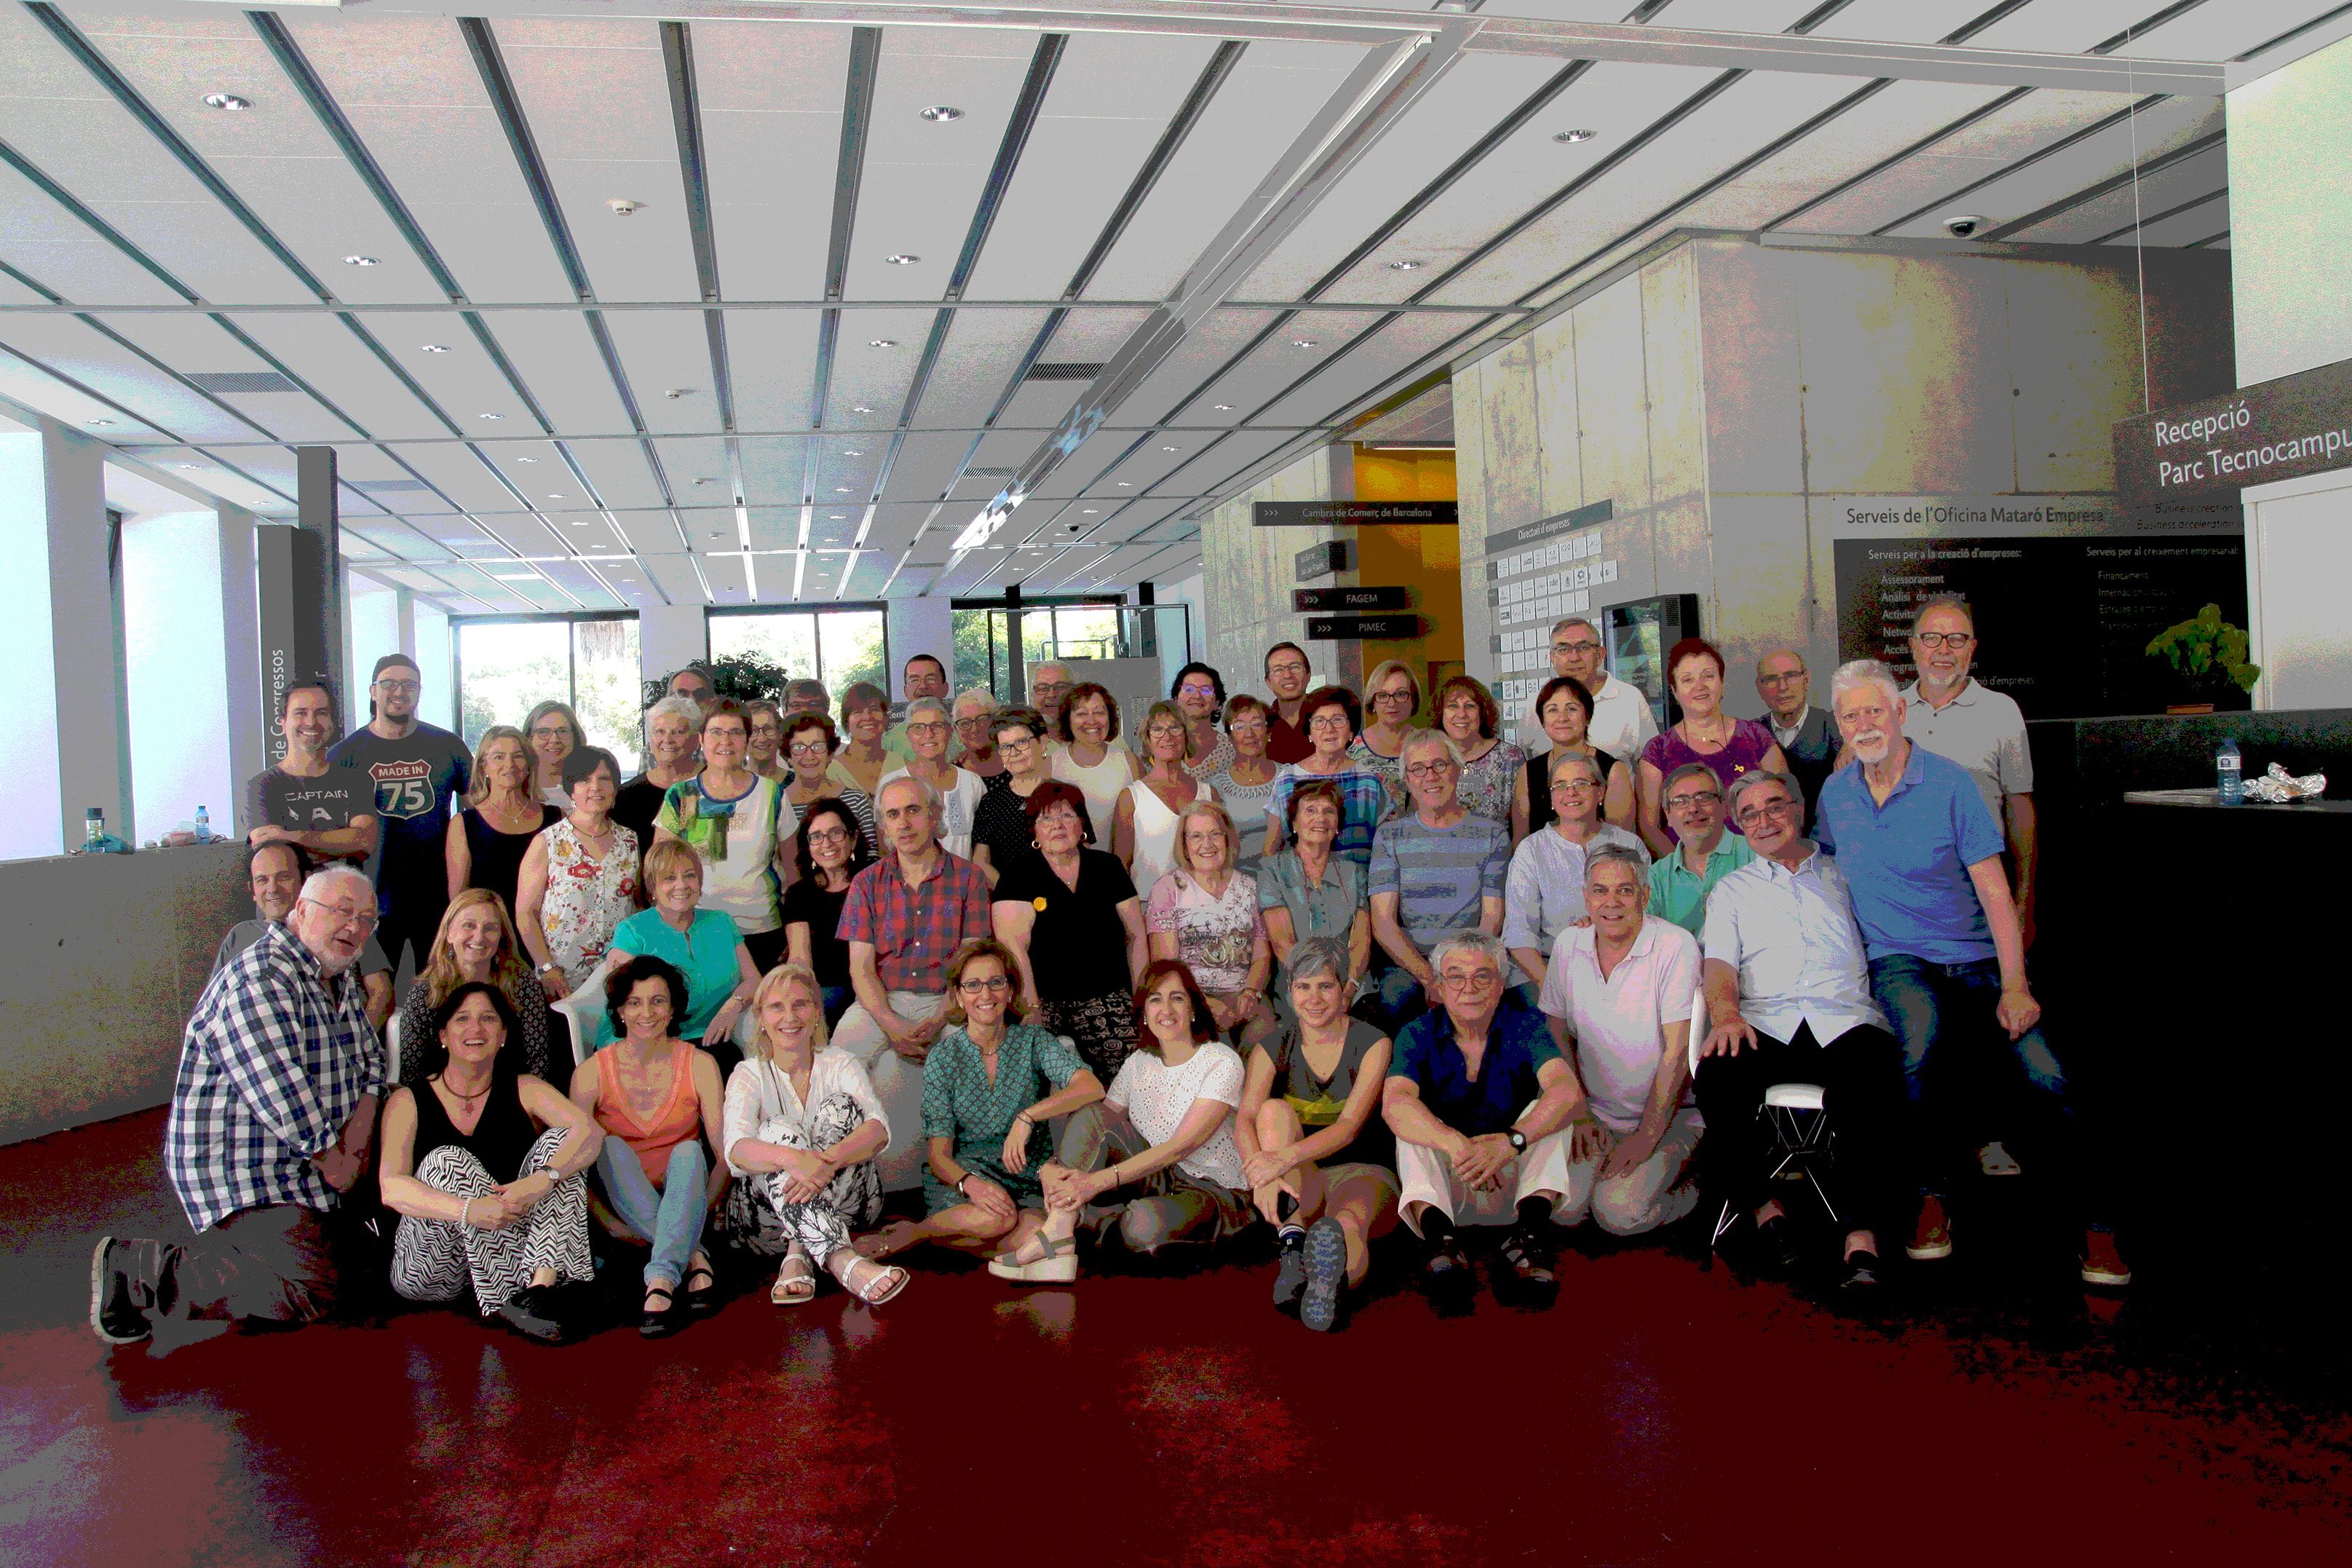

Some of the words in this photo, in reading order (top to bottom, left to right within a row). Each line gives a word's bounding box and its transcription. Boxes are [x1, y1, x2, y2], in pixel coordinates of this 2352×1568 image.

[2155, 400, 2250, 446] Recepció
[2159, 462, 2203, 486] Parc
[2207, 427, 2352, 475] Tecnocampu
[1302, 508, 1334, 517] Cambra
[1337, 508, 1346, 517] de
[1347, 508, 1379, 518] Comerç
[1381, 507, 1390, 517] de
[1393, 507, 1433, 517] Barcelona
[1847, 507, 1899, 523] Serveis
[1904, 507, 1921, 523] de
[1925, 506, 1987, 523] l'Oficina
[1991, 505, 2043, 523] Mataró
[2046, 507, 2104, 525] Empresa
[1518, 524, 1540, 540] Directori
[1540, 518, 1570, 534] d'empreses
[1869, 549, 1901, 560] Serveis
[1904, 551, 1918, 561] per
[1928, 548, 1936, 558] la
[1938, 547, 1969, 558] creació
[1971, 547, 2022, 561] d'empreses:
[2086, 546, 2116, 556] Serveis
[2118, 548, 2132, 558] per
[2134, 546, 2141, 555] al
[2143, 547, 2189, 556] creixement
[1881, 574, 1945, 584] Assessorament
[2098, 570, 2149, 580] Finançament
[1346, 594, 1377, 603] FAGEM
[1358, 622, 1387, 632] PIMEC
[378, 767, 410, 777] MADE
[411, 766, 424, 775] IN
[285, 789, 349, 801] CAPTAIN
[381, 780, 426, 812] 75
